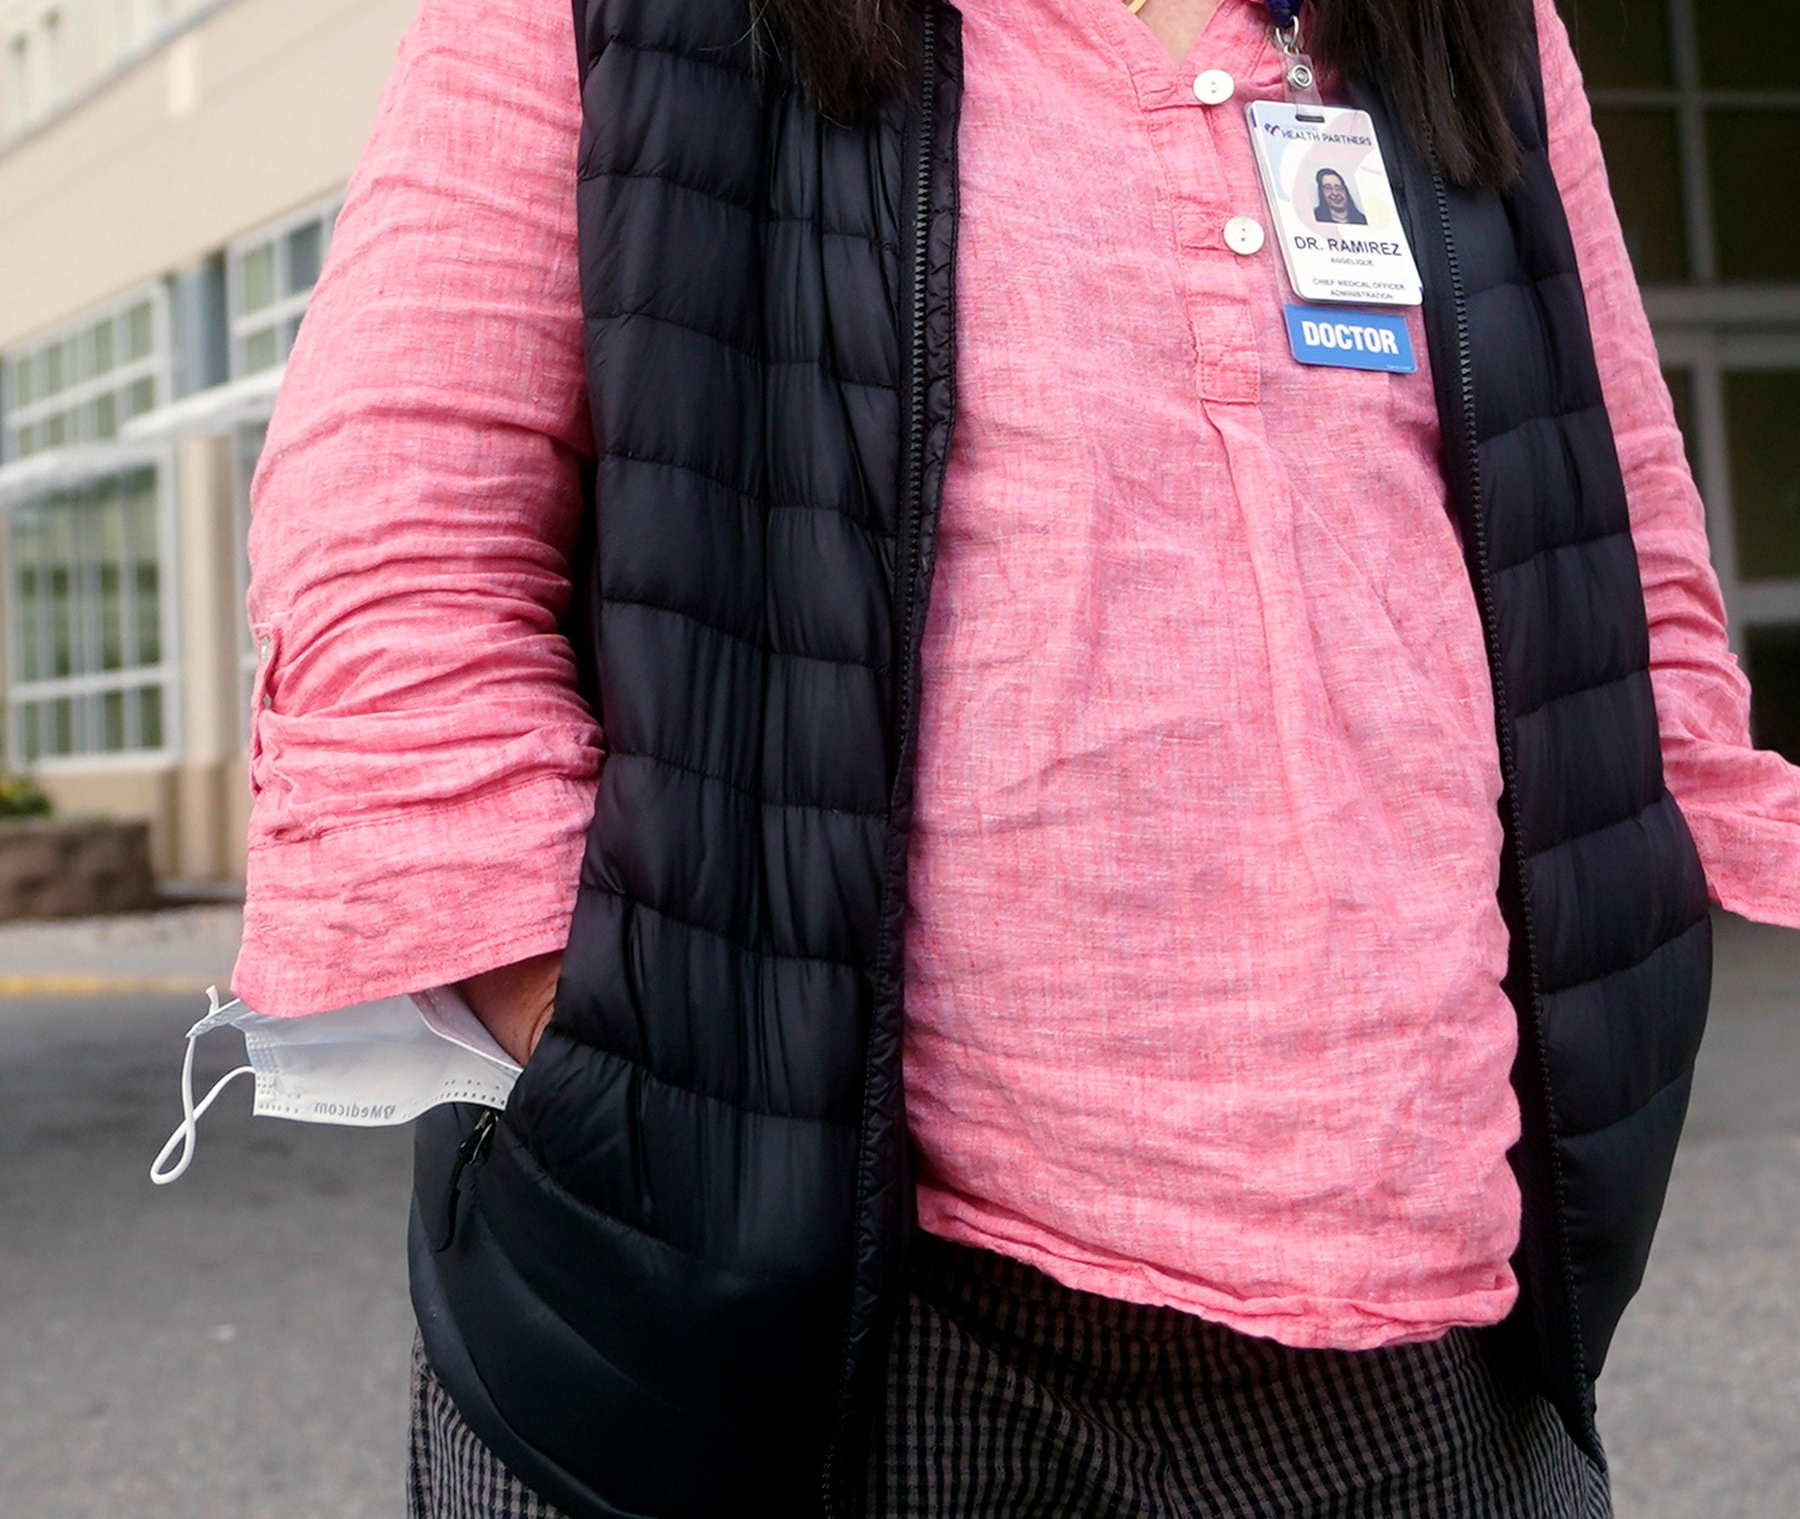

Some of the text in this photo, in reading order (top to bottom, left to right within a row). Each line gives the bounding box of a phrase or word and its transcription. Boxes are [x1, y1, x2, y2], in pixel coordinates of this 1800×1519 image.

[1281, 129, 1372, 147] HEALTH PARTNERS
[1294, 236, 1402, 256] DR. RAMIREZ
[1312, 277, 1406, 291] CHIEF MEDICAL OFFICER
[1330, 289, 1395, 300] ADMINISTRATION
[1301, 320, 1399, 355] DOCTOR
